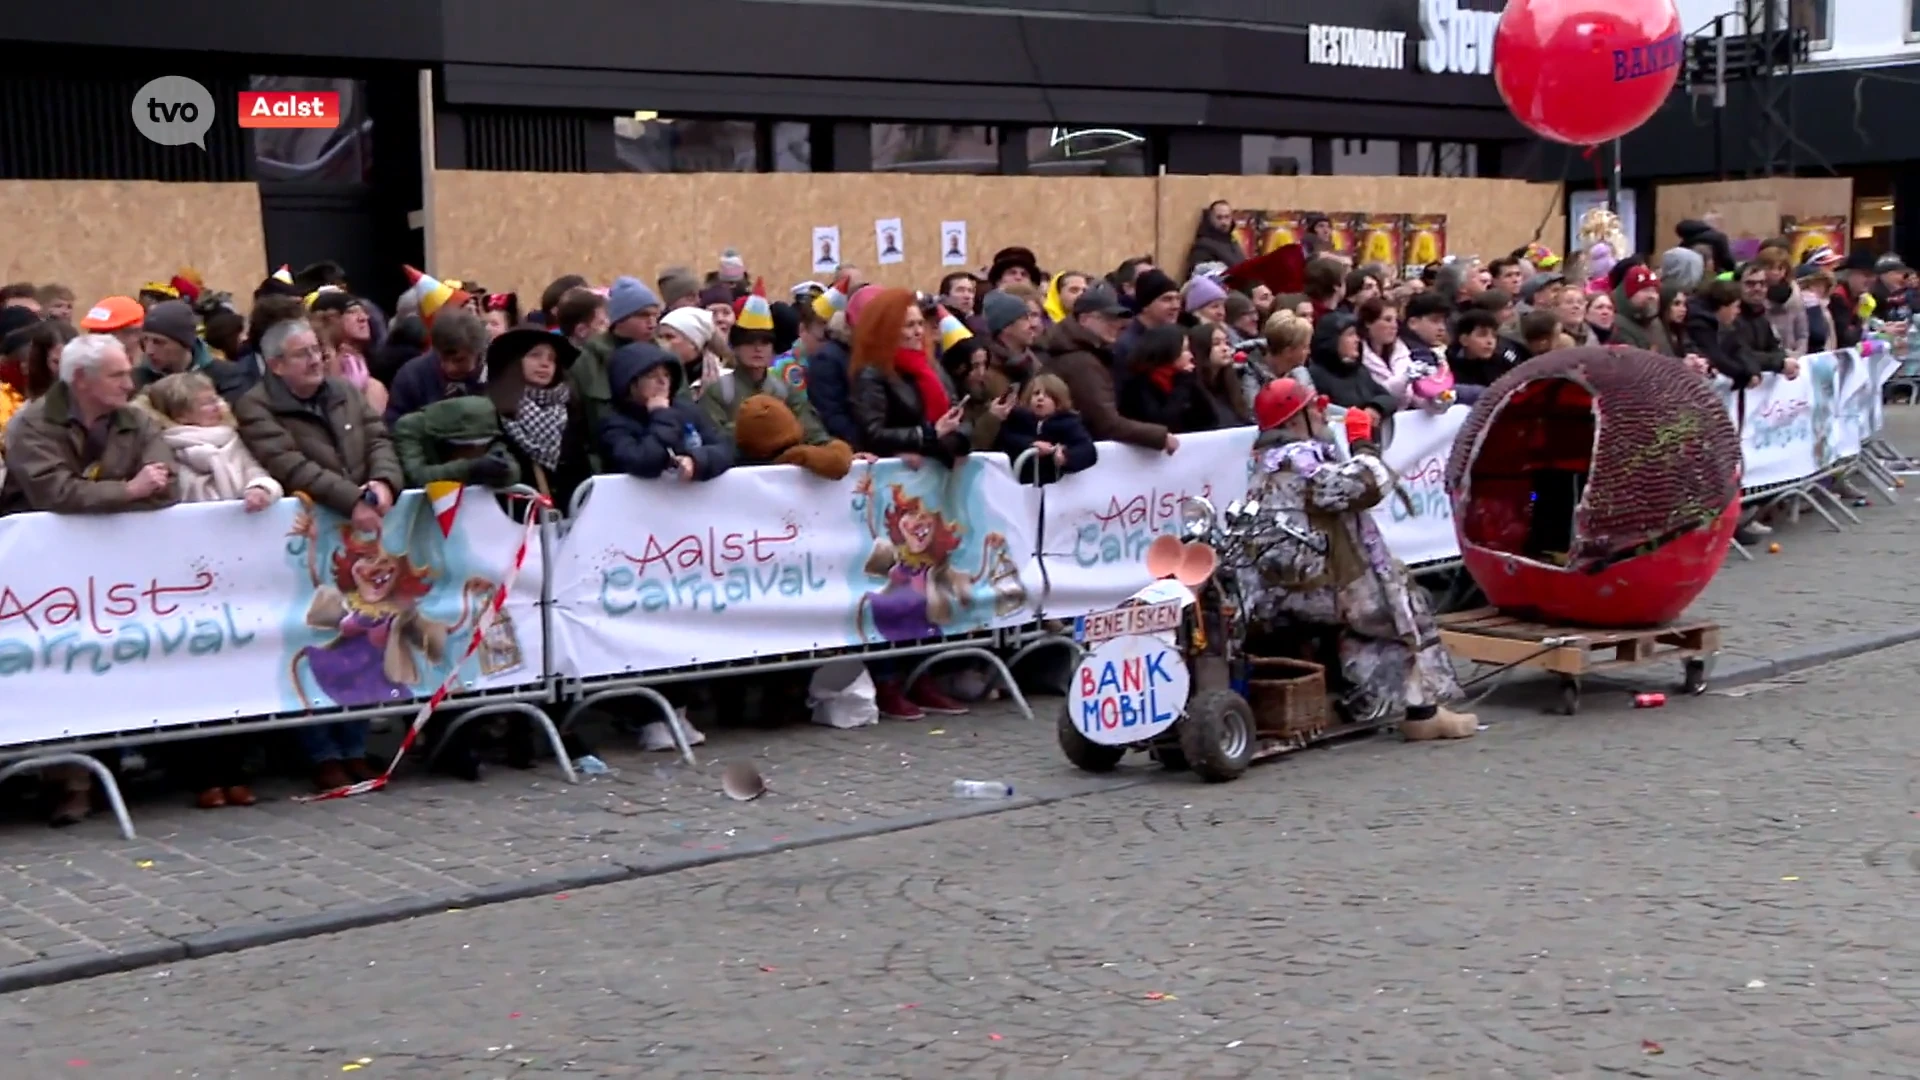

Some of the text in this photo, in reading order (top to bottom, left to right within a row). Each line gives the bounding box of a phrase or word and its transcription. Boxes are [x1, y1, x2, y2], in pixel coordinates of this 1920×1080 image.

[1308, 23, 1406, 70] RESTAURANT
[622, 524, 798, 577] Aalst
[0, 571, 214, 634] Aalst
[601, 550, 826, 619] Carnaval
[1081, 650, 1173, 698] BANK
